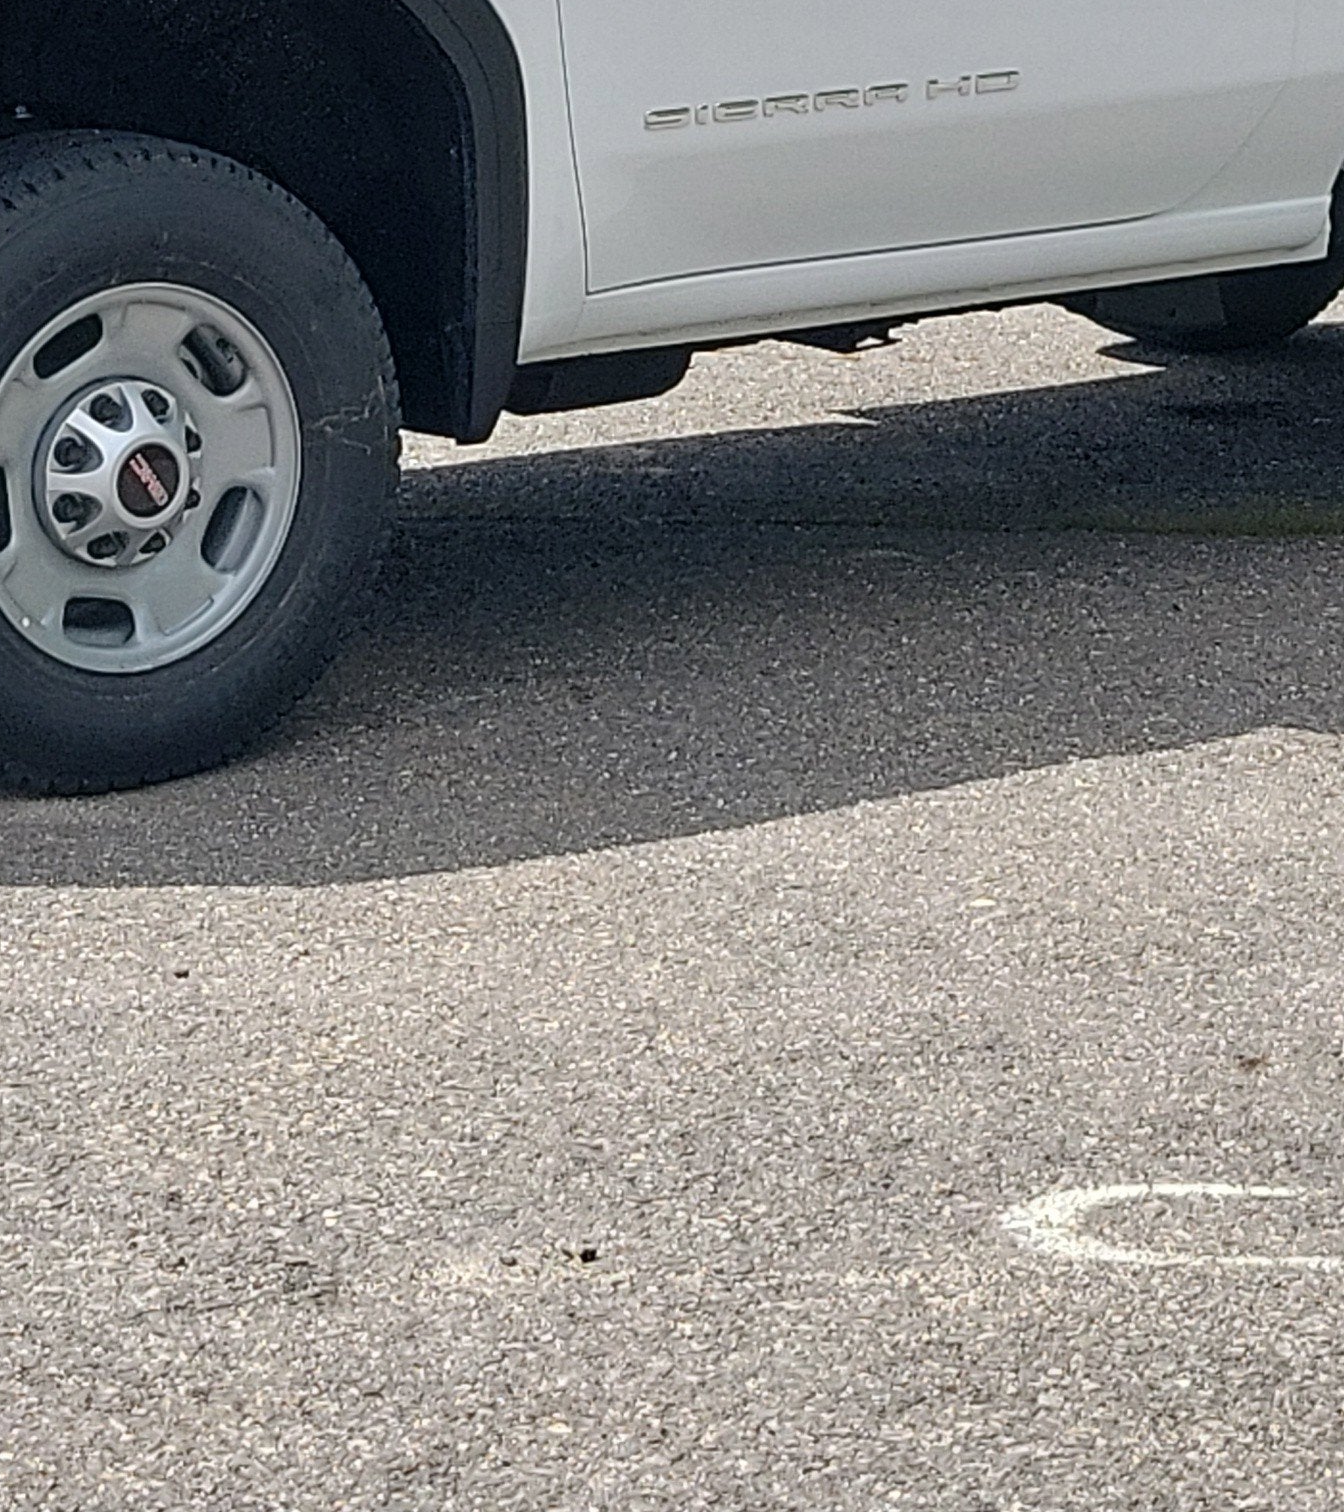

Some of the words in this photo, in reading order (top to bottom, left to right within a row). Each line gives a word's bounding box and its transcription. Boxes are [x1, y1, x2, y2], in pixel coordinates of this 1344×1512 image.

[644, 83, 908, 129] SIERRA
[925, 71, 1020, 100] HD
[129, 453, 169, 506] GMC
